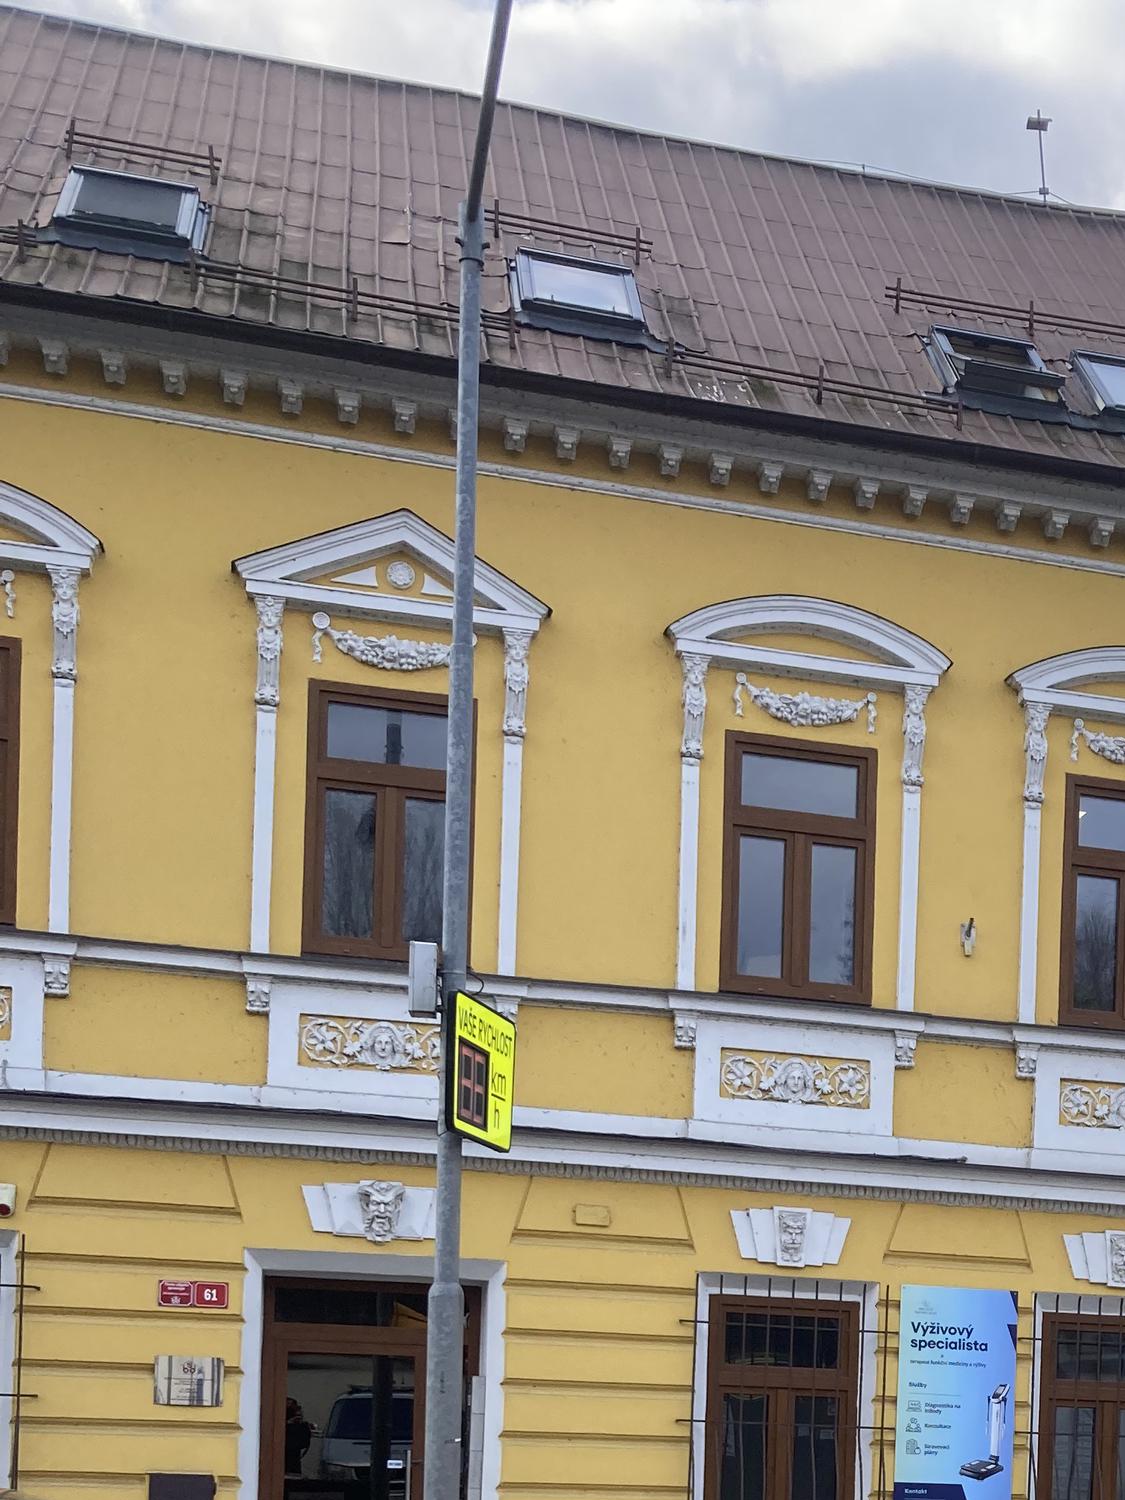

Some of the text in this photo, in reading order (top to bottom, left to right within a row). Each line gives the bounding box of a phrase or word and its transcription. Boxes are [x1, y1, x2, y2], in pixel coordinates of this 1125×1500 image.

[459, 1006, 512, 1057] VAŠE RYCHLOST
[491, 1062, 506, 1096] km
[493, 1100, 500, 1130] h
[203, 1288, 218, 1301] 61
[911, 1321, 974, 1339] Výživový
[910, 1338, 989, 1352] specialista
[908, 1381, 927, 1389] Služby
